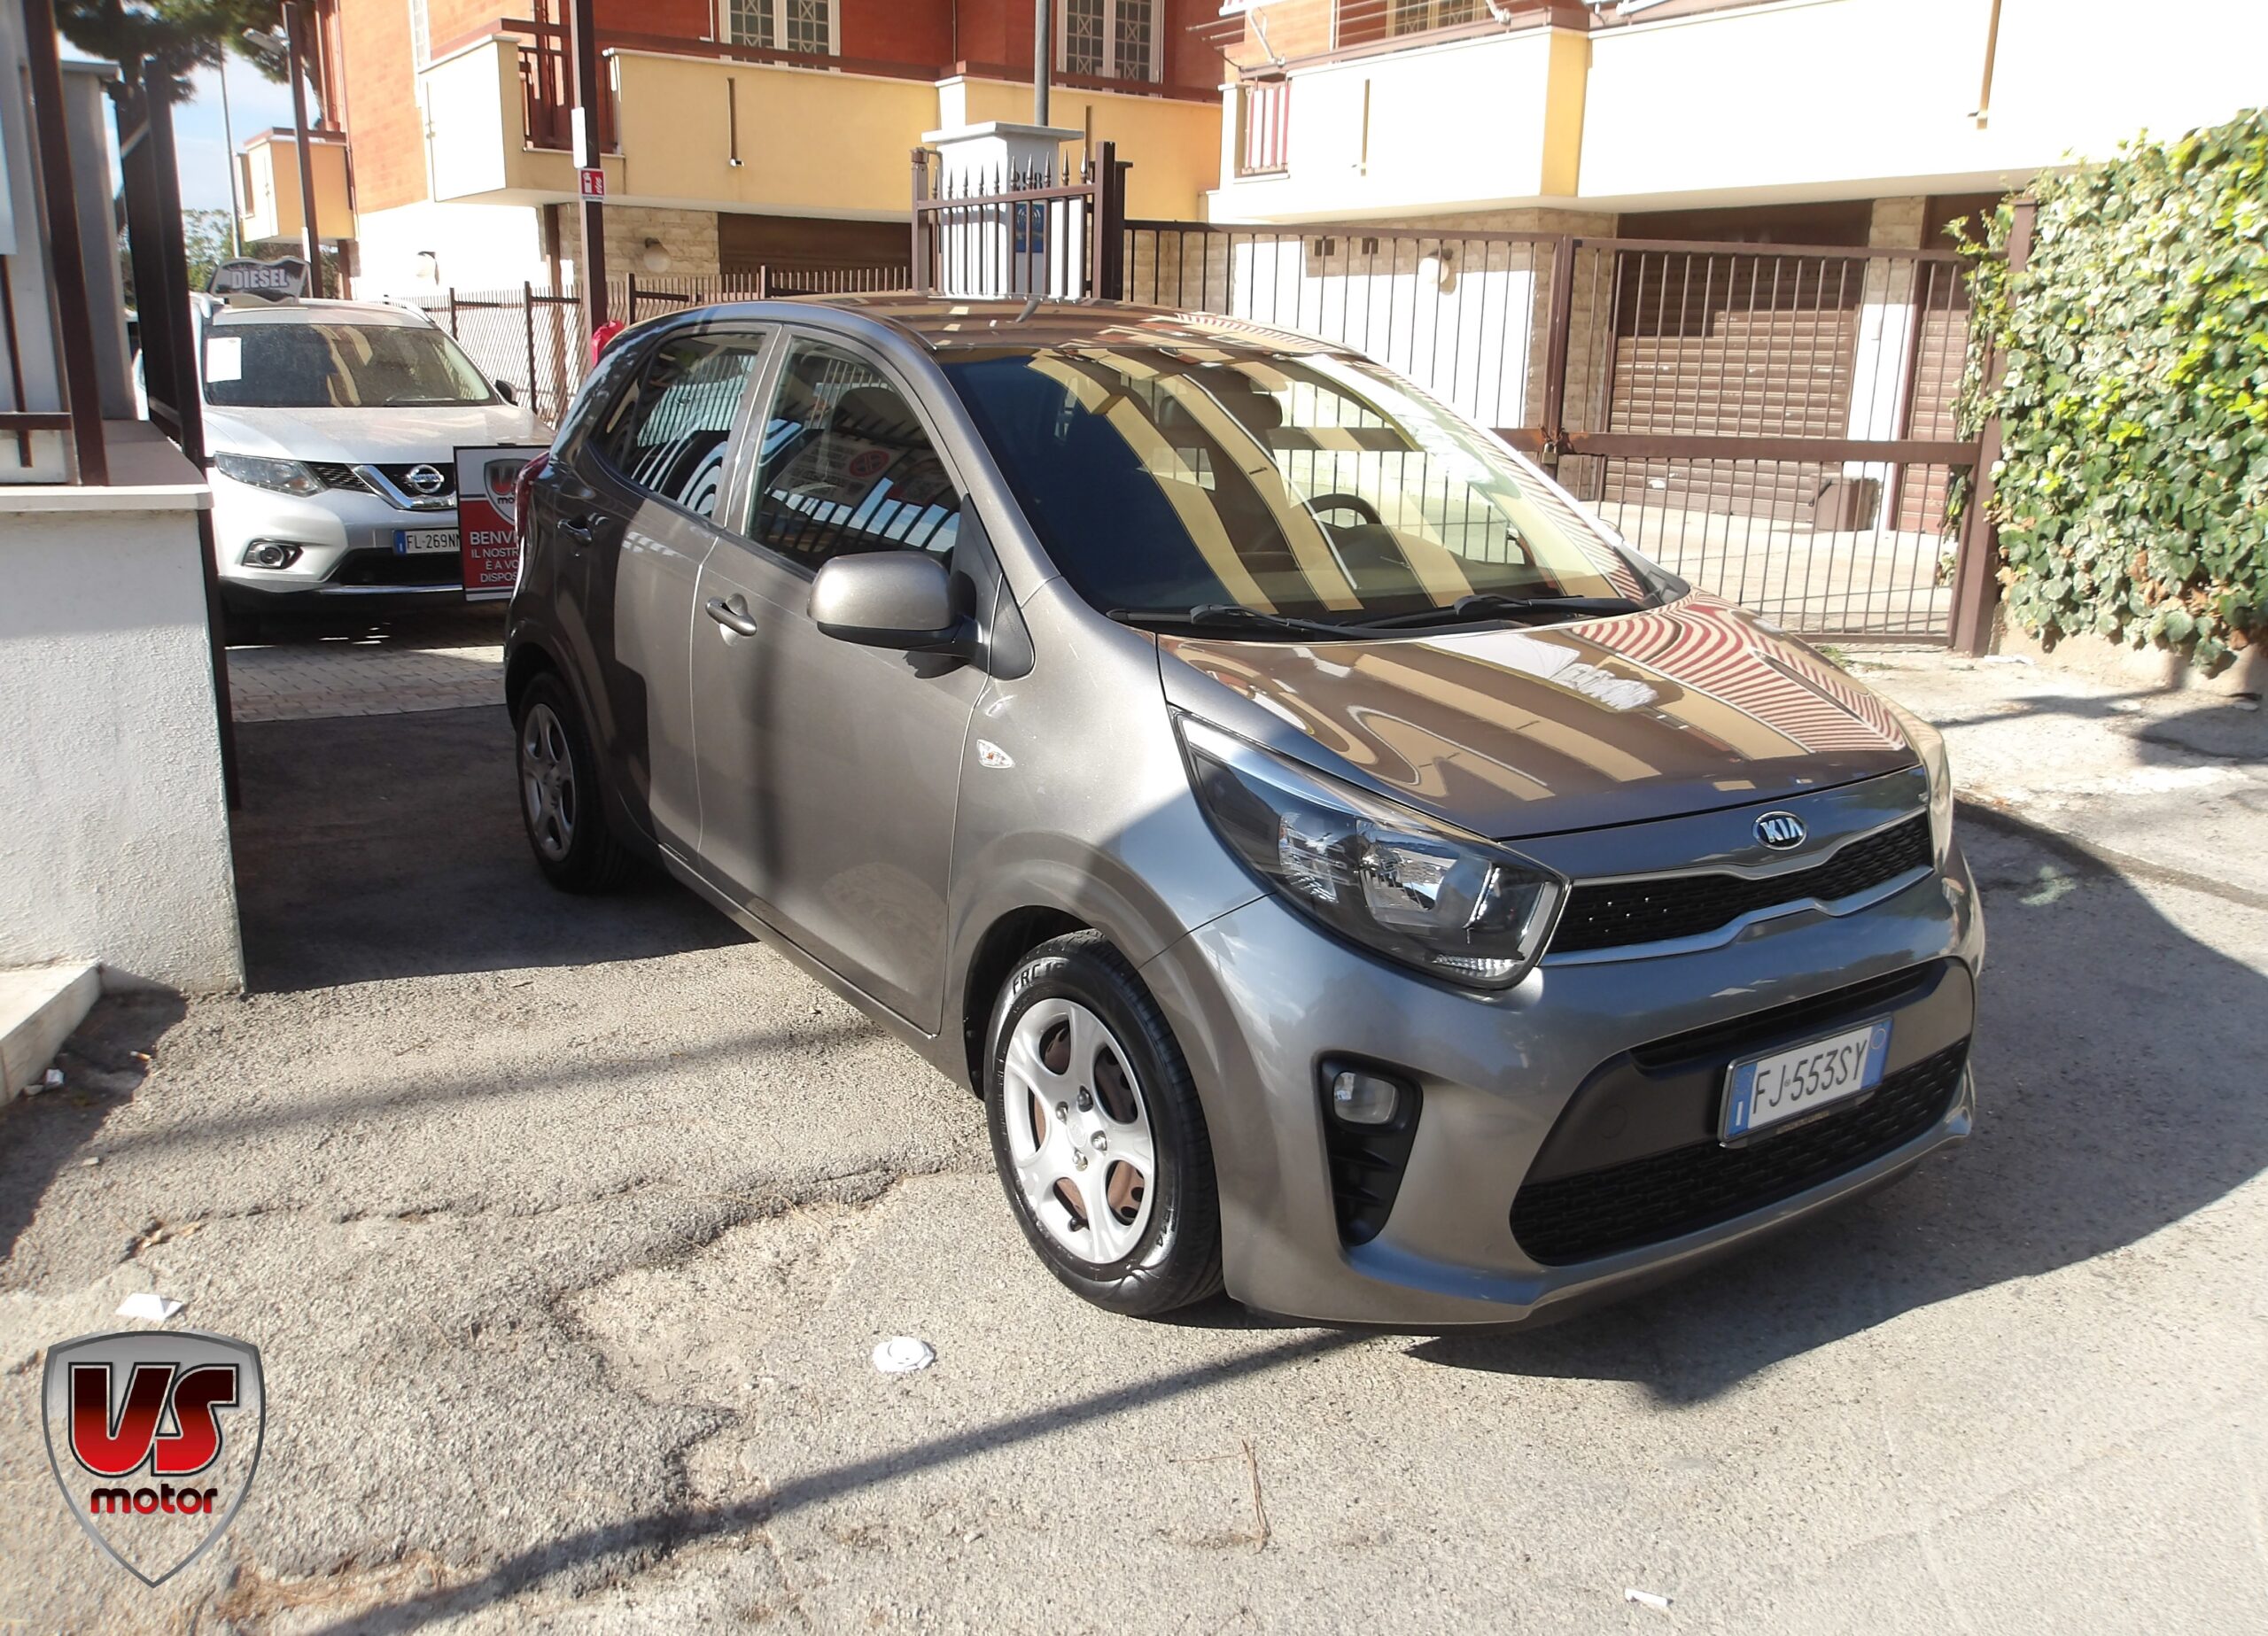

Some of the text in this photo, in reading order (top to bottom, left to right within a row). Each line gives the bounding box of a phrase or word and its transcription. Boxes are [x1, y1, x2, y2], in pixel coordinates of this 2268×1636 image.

[231, 268, 288, 289] DIESEL
[470, 531, 518, 546] BENV
[471, 547, 519, 559] IL NOSTR
[494, 561, 502, 570] A
[504, 559, 519, 570] VO
[480, 571, 517, 583] DISPOS
[1759, 817, 1804, 843] KIA
